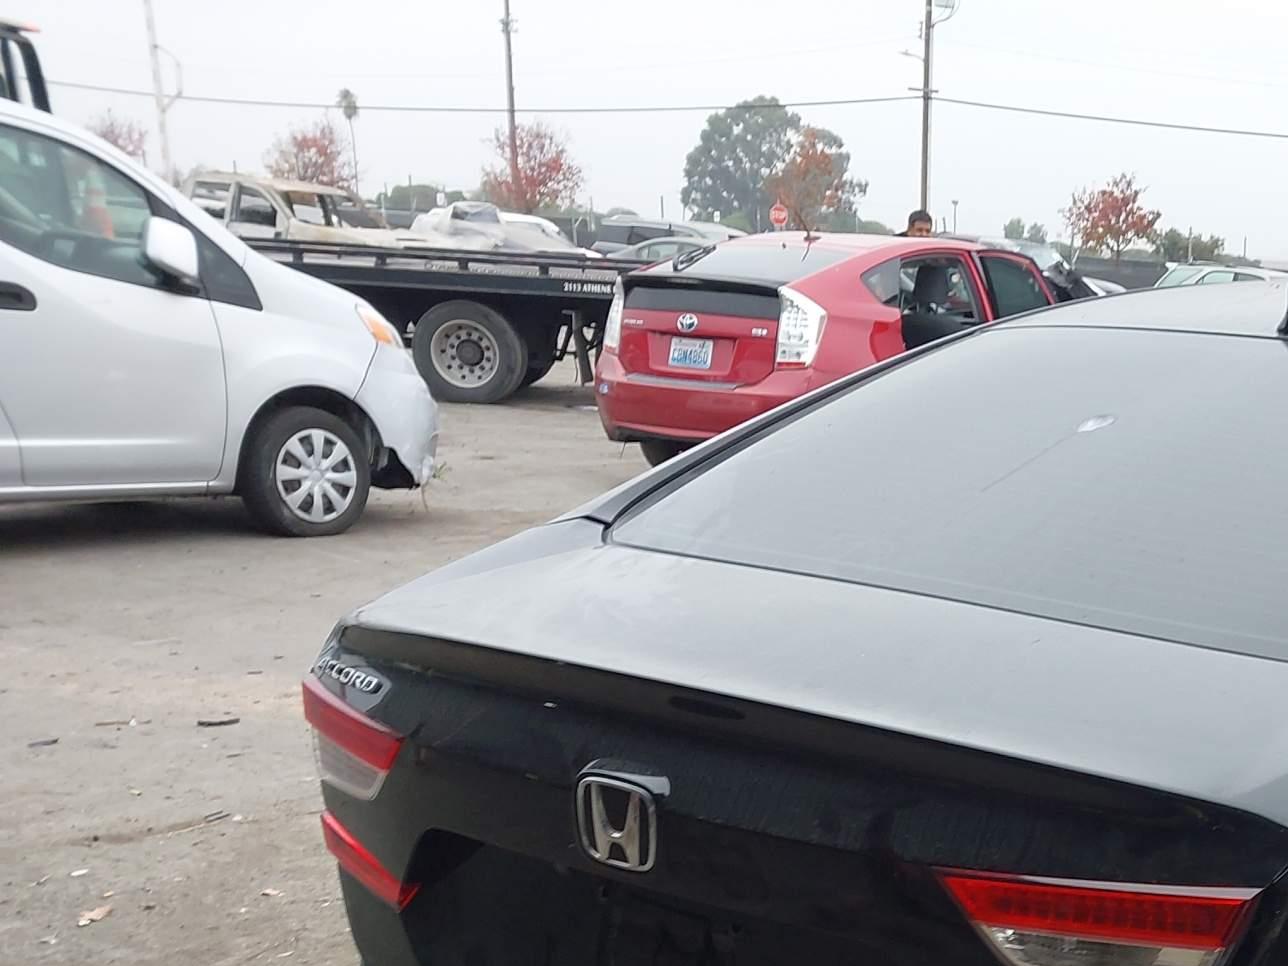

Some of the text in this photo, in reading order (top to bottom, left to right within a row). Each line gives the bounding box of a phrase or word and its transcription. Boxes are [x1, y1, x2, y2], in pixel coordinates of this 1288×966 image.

[563, 281, 582, 292] 2113
[582, 283, 612, 294] ATHENS
[314, 656, 381, 693] ACCORD
